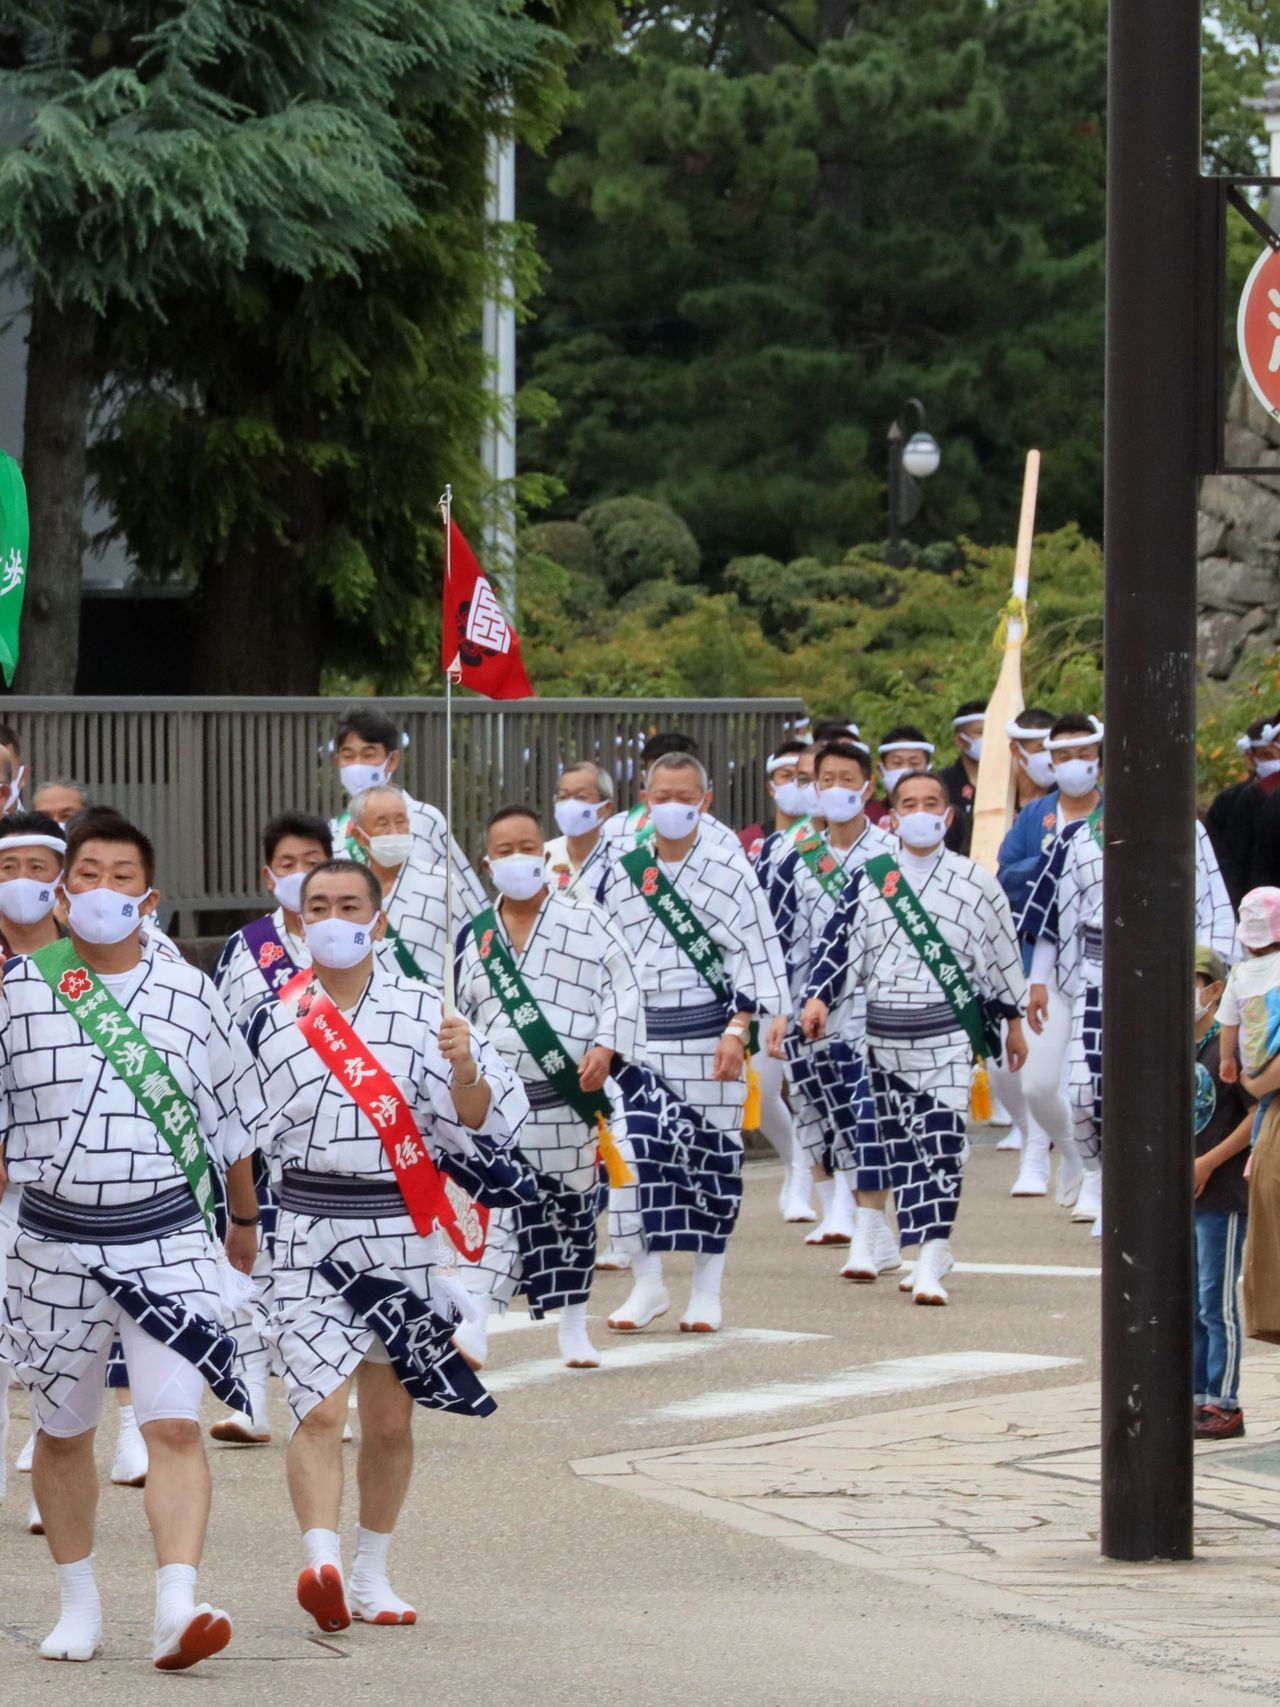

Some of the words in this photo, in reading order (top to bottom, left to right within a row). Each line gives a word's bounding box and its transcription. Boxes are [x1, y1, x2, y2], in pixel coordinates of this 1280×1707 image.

[657, 892, 695, 935] 宮本町
[895, 895, 928, 936] 宮本町
[923, 940, 972, 1010] 分会長
[488, 956, 521, 1000] 宮本町
[513, 1001, 567, 1075] 総務
[74, 989, 109, 1019] 宮本町
[95, 1010, 200, 1168] 交渉責任者
[313, 1013, 348, 1053] 宮本町
[343, 1056, 426, 1170] 交渉係
